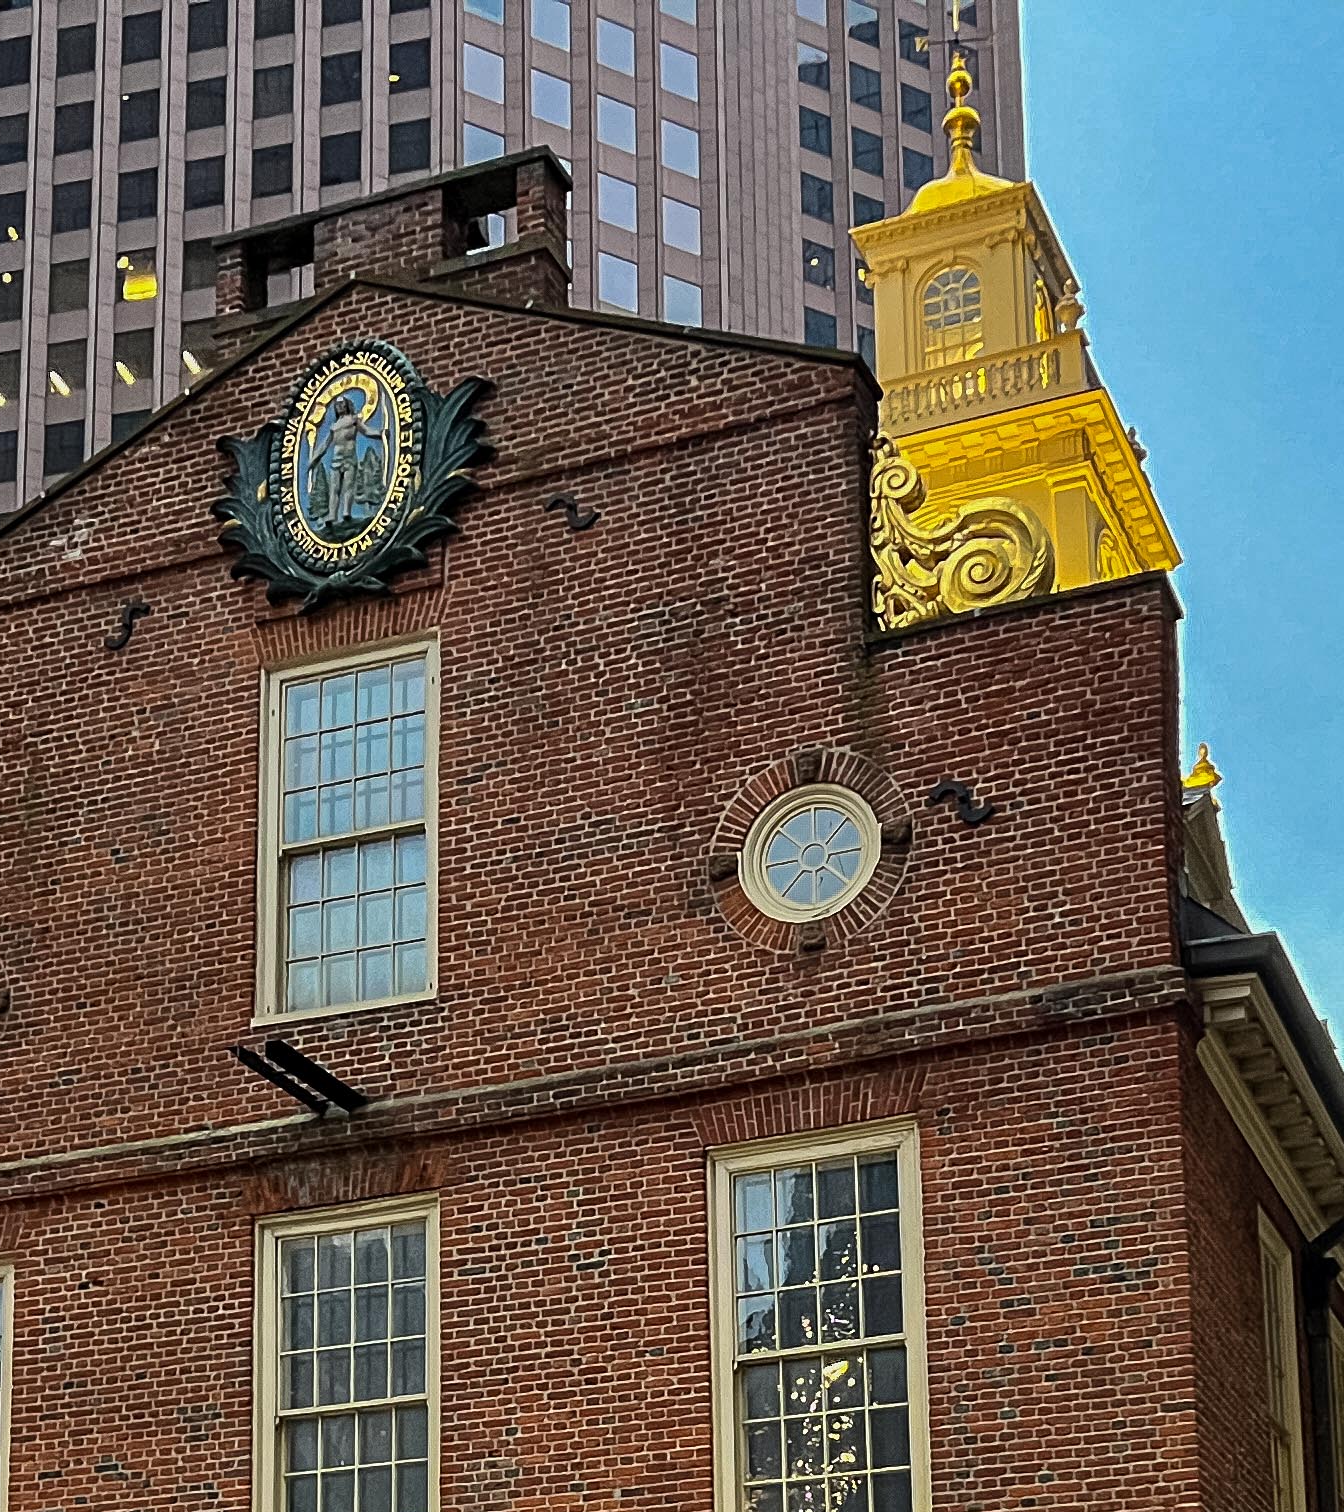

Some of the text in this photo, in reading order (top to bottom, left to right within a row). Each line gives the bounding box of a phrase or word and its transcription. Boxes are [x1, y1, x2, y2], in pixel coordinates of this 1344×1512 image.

[282, 416, 301, 459] NOVA
[400, 430, 413, 447] ET
[281, 463, 293, 480] IN
[281, 486, 295, 514] BAY
[372, 515, 392, 536] DE
